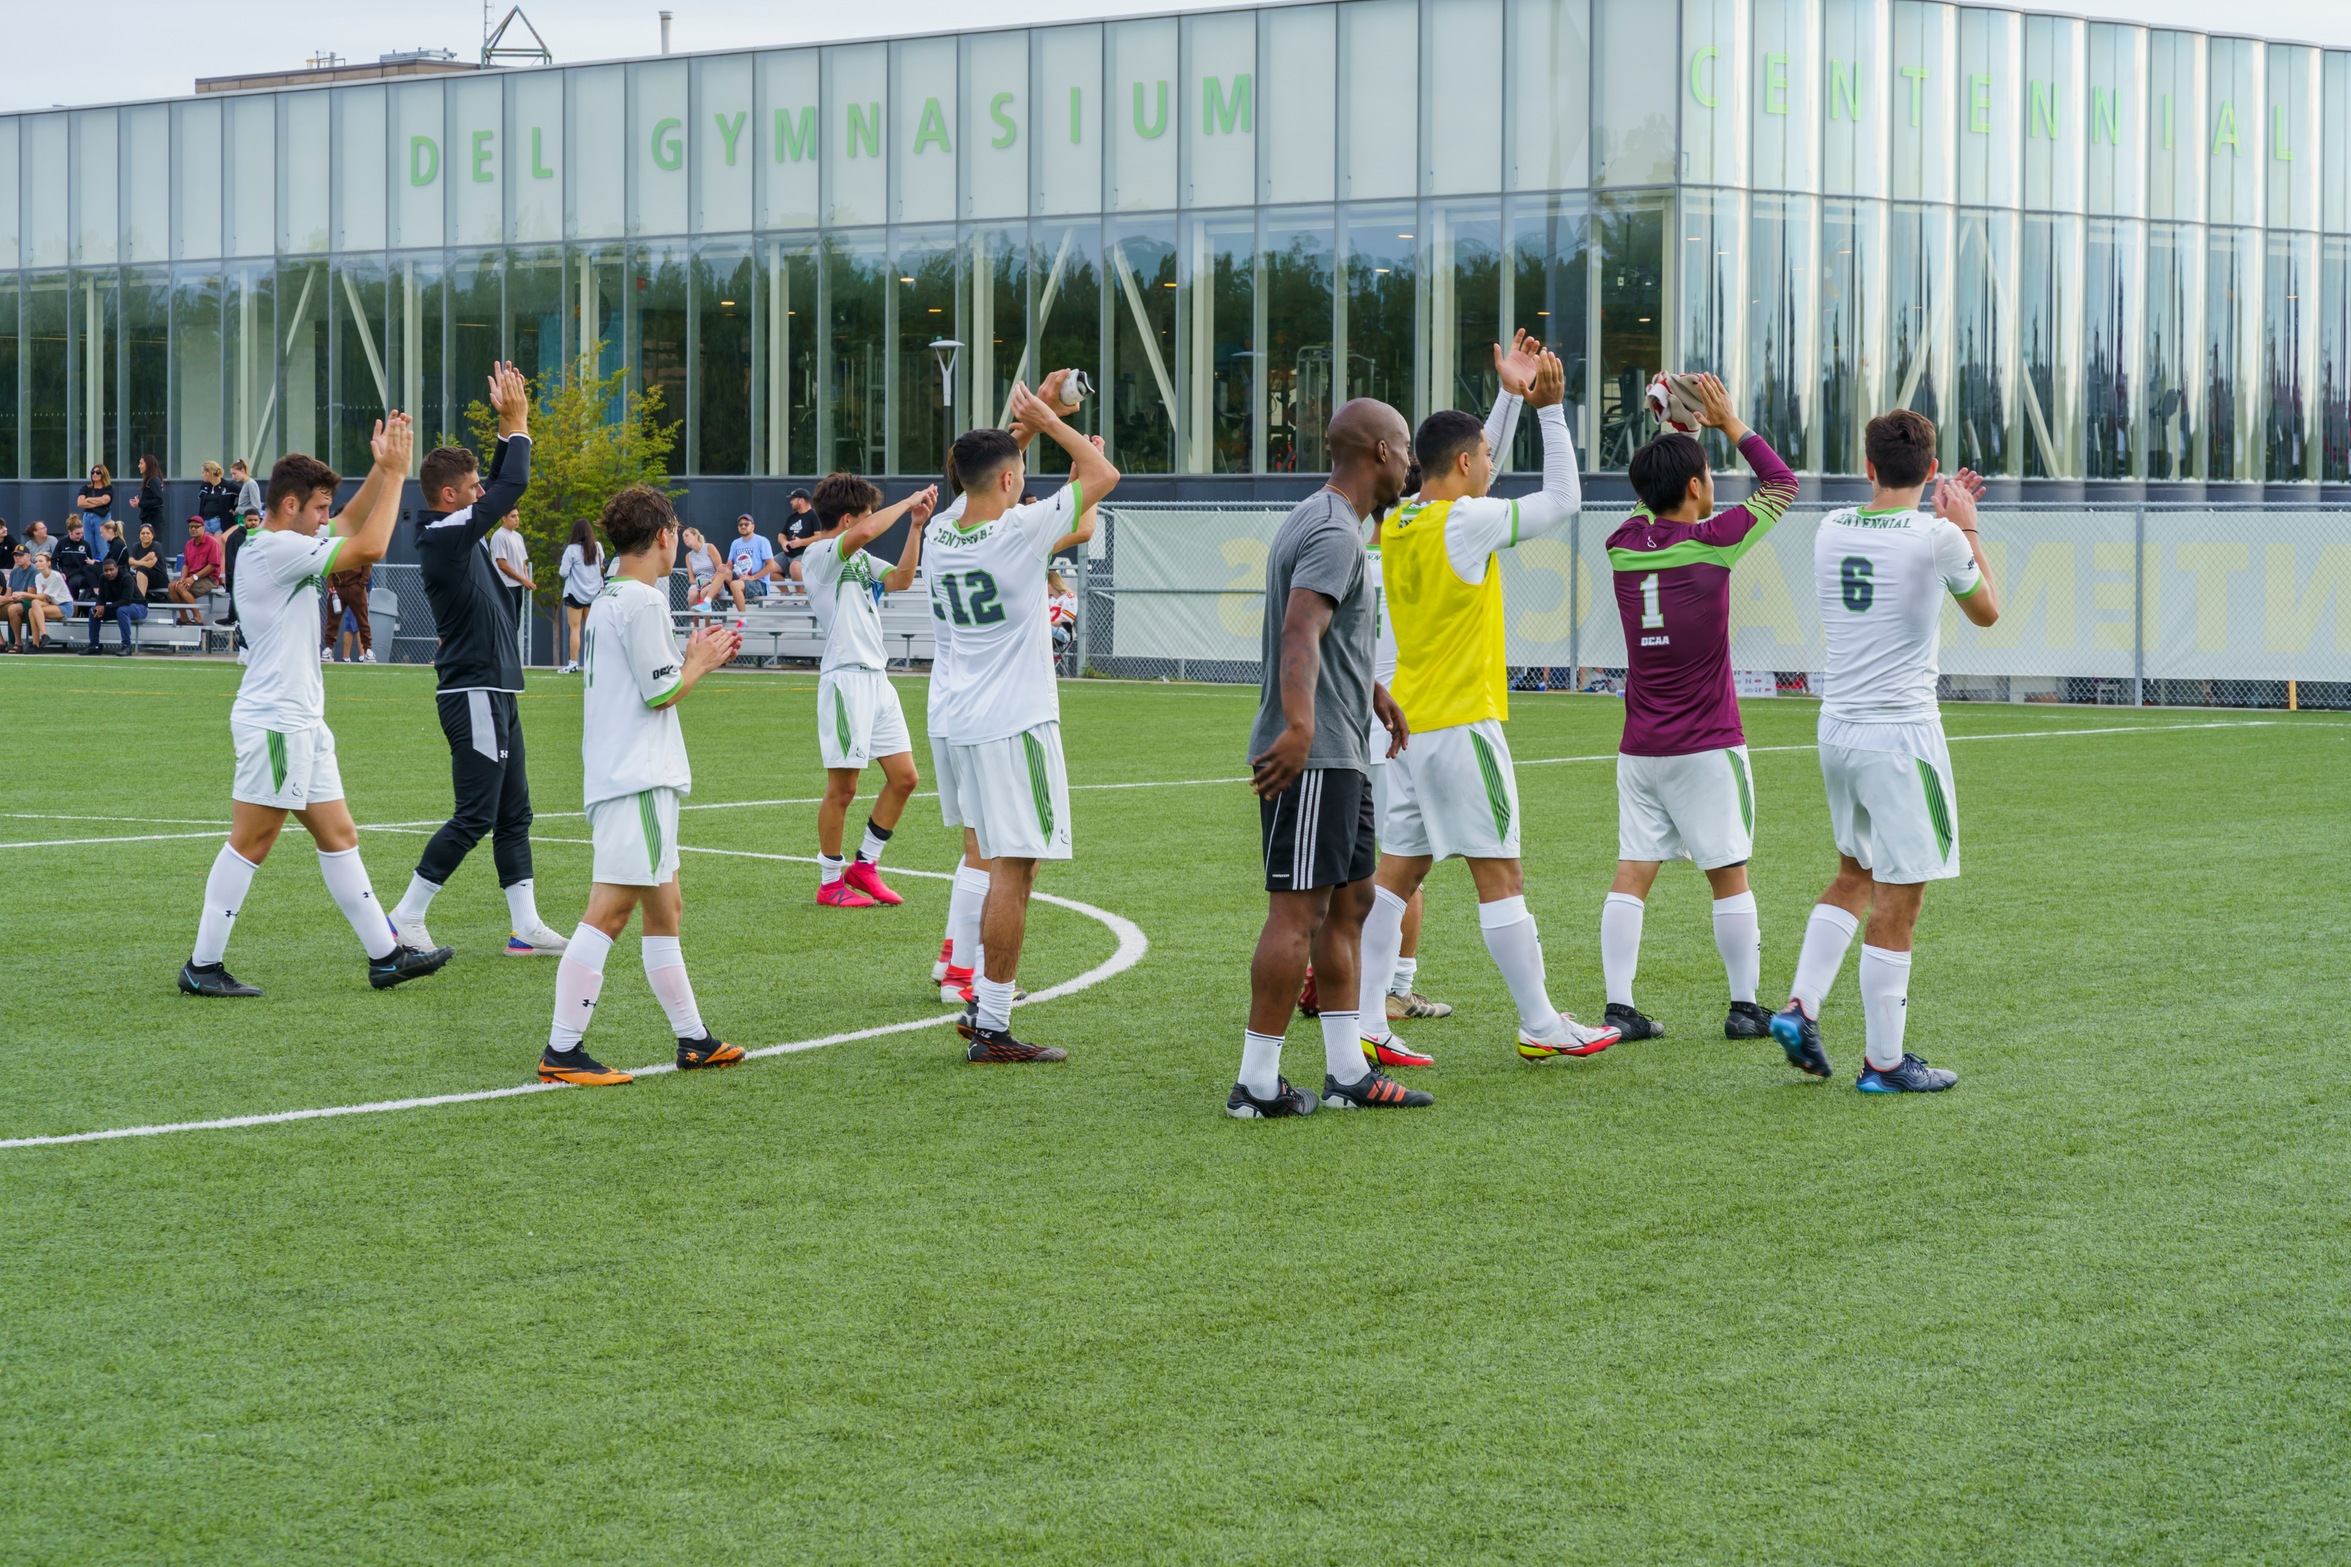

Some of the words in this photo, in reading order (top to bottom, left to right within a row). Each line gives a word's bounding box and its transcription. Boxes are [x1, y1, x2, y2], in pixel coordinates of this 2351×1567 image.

[410, 126, 553, 187] DEL
[651, 73, 1252, 172] GYMNASIUM
[1690, 45, 2294, 161] CENTENNIAL
[942, 568, 1007, 627] 12
[1640, 572, 1664, 629] 1
[1840, 555, 1875, 613] 6
